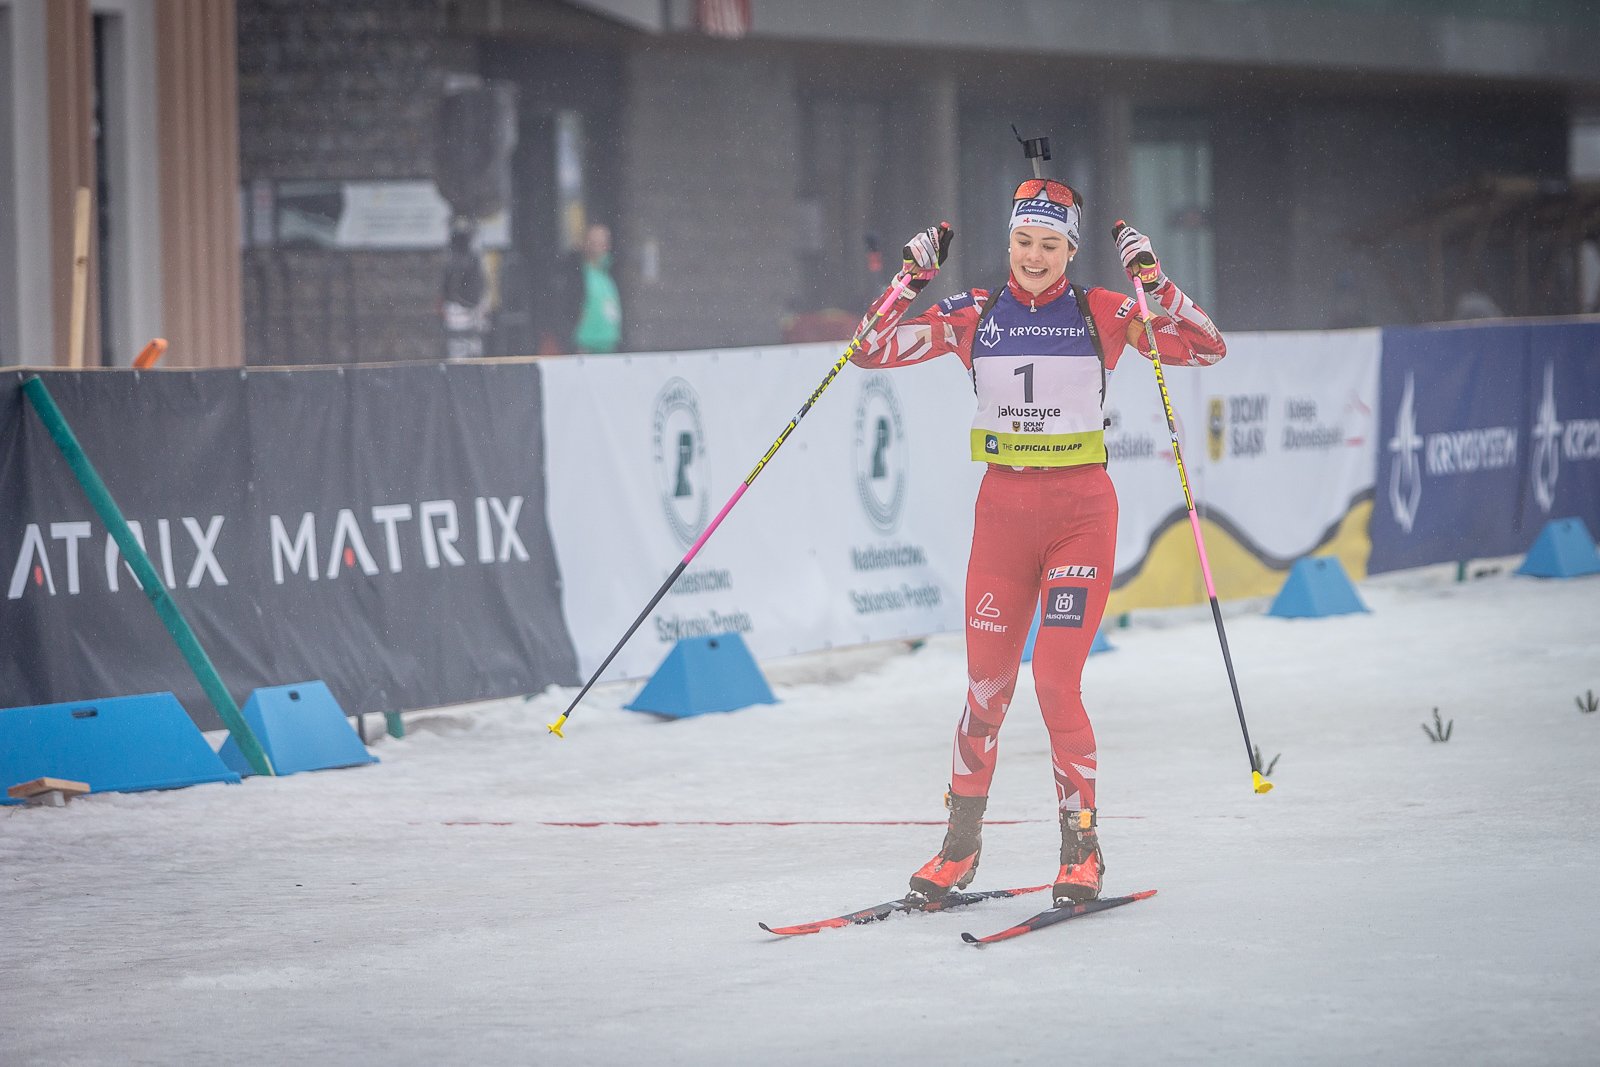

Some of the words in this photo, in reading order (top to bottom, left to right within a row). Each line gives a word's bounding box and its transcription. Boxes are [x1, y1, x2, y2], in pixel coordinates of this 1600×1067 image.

[1009, 325, 1085, 338] KRYOSYSTEM
[1013, 362, 1034, 404] 1
[997, 405, 1062, 421] Jakuszyce
[1014, 444, 1051, 452] OFFICIAL
[1052, 444, 1066, 452] IBU
[1067, 443, 1083, 451] APP
[269, 495, 531, 586] MATRIX
[1048, 566, 1096, 580] HELLA
[969, 616, 1008, 633] Löffler
[1046, 613, 1081, 621] Husqvarna
